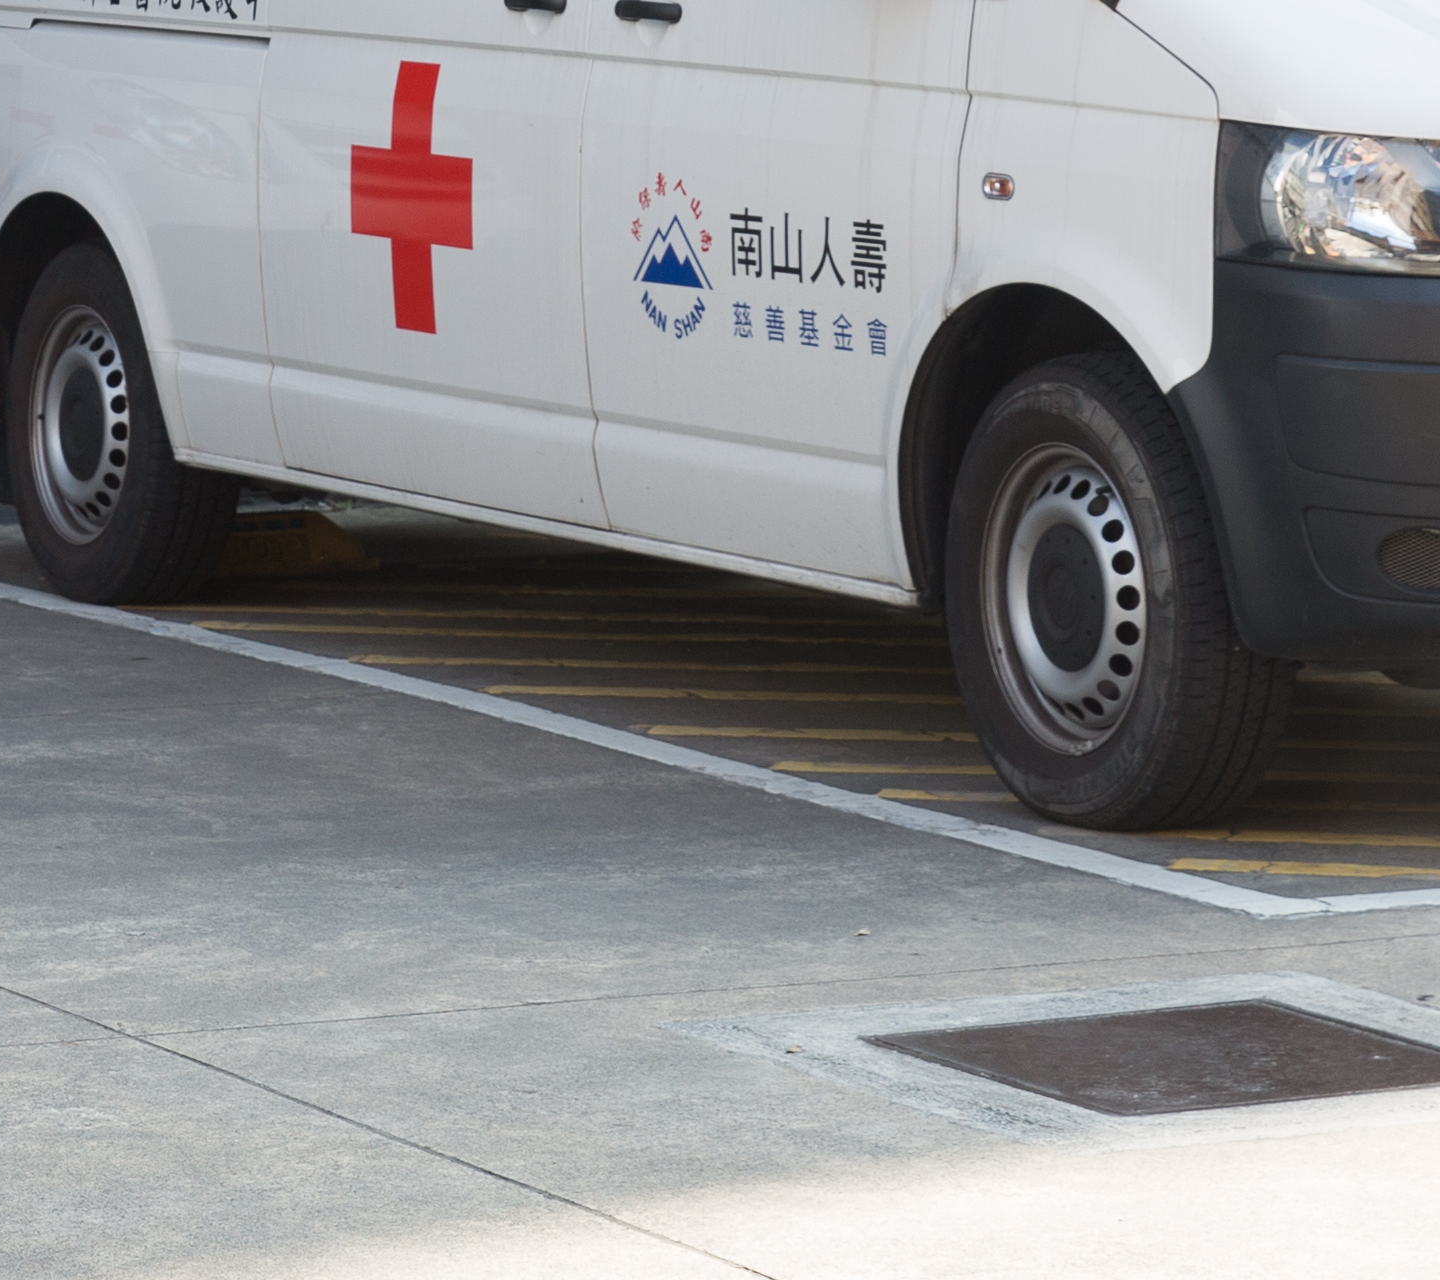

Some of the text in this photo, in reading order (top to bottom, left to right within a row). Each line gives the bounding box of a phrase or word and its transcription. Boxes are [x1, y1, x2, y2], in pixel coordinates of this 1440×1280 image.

[730, 207, 888, 294] 南山人壽
[641, 290, 707, 340] NAN SHAN
[732, 301, 889, 357] 慈善基金會
